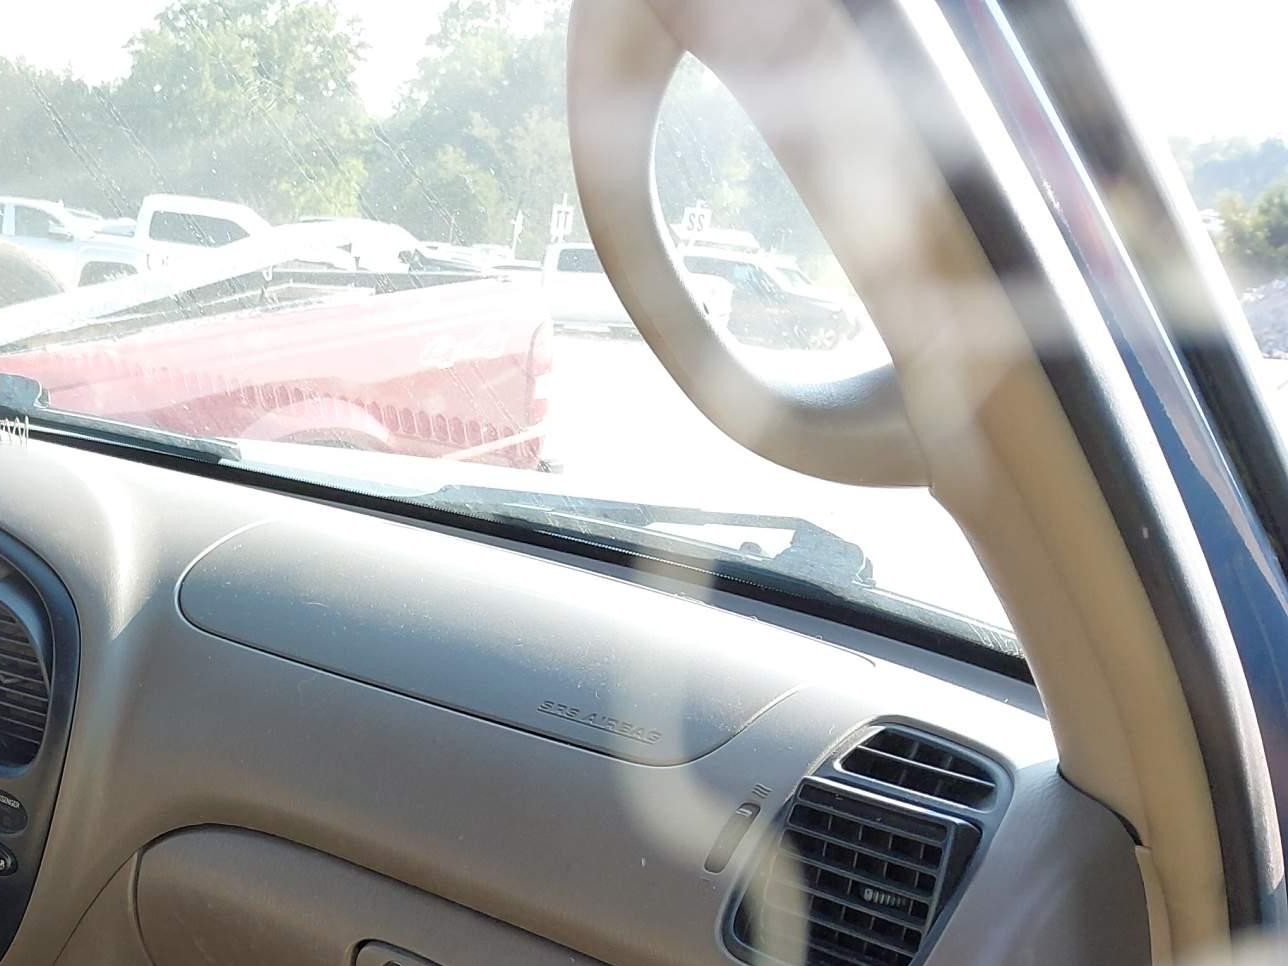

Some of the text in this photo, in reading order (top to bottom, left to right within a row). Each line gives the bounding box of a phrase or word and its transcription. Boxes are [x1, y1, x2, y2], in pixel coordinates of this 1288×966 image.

[687, 213, 705, 231] SS
[537, 700, 663, 743] SRS AIRBAG
